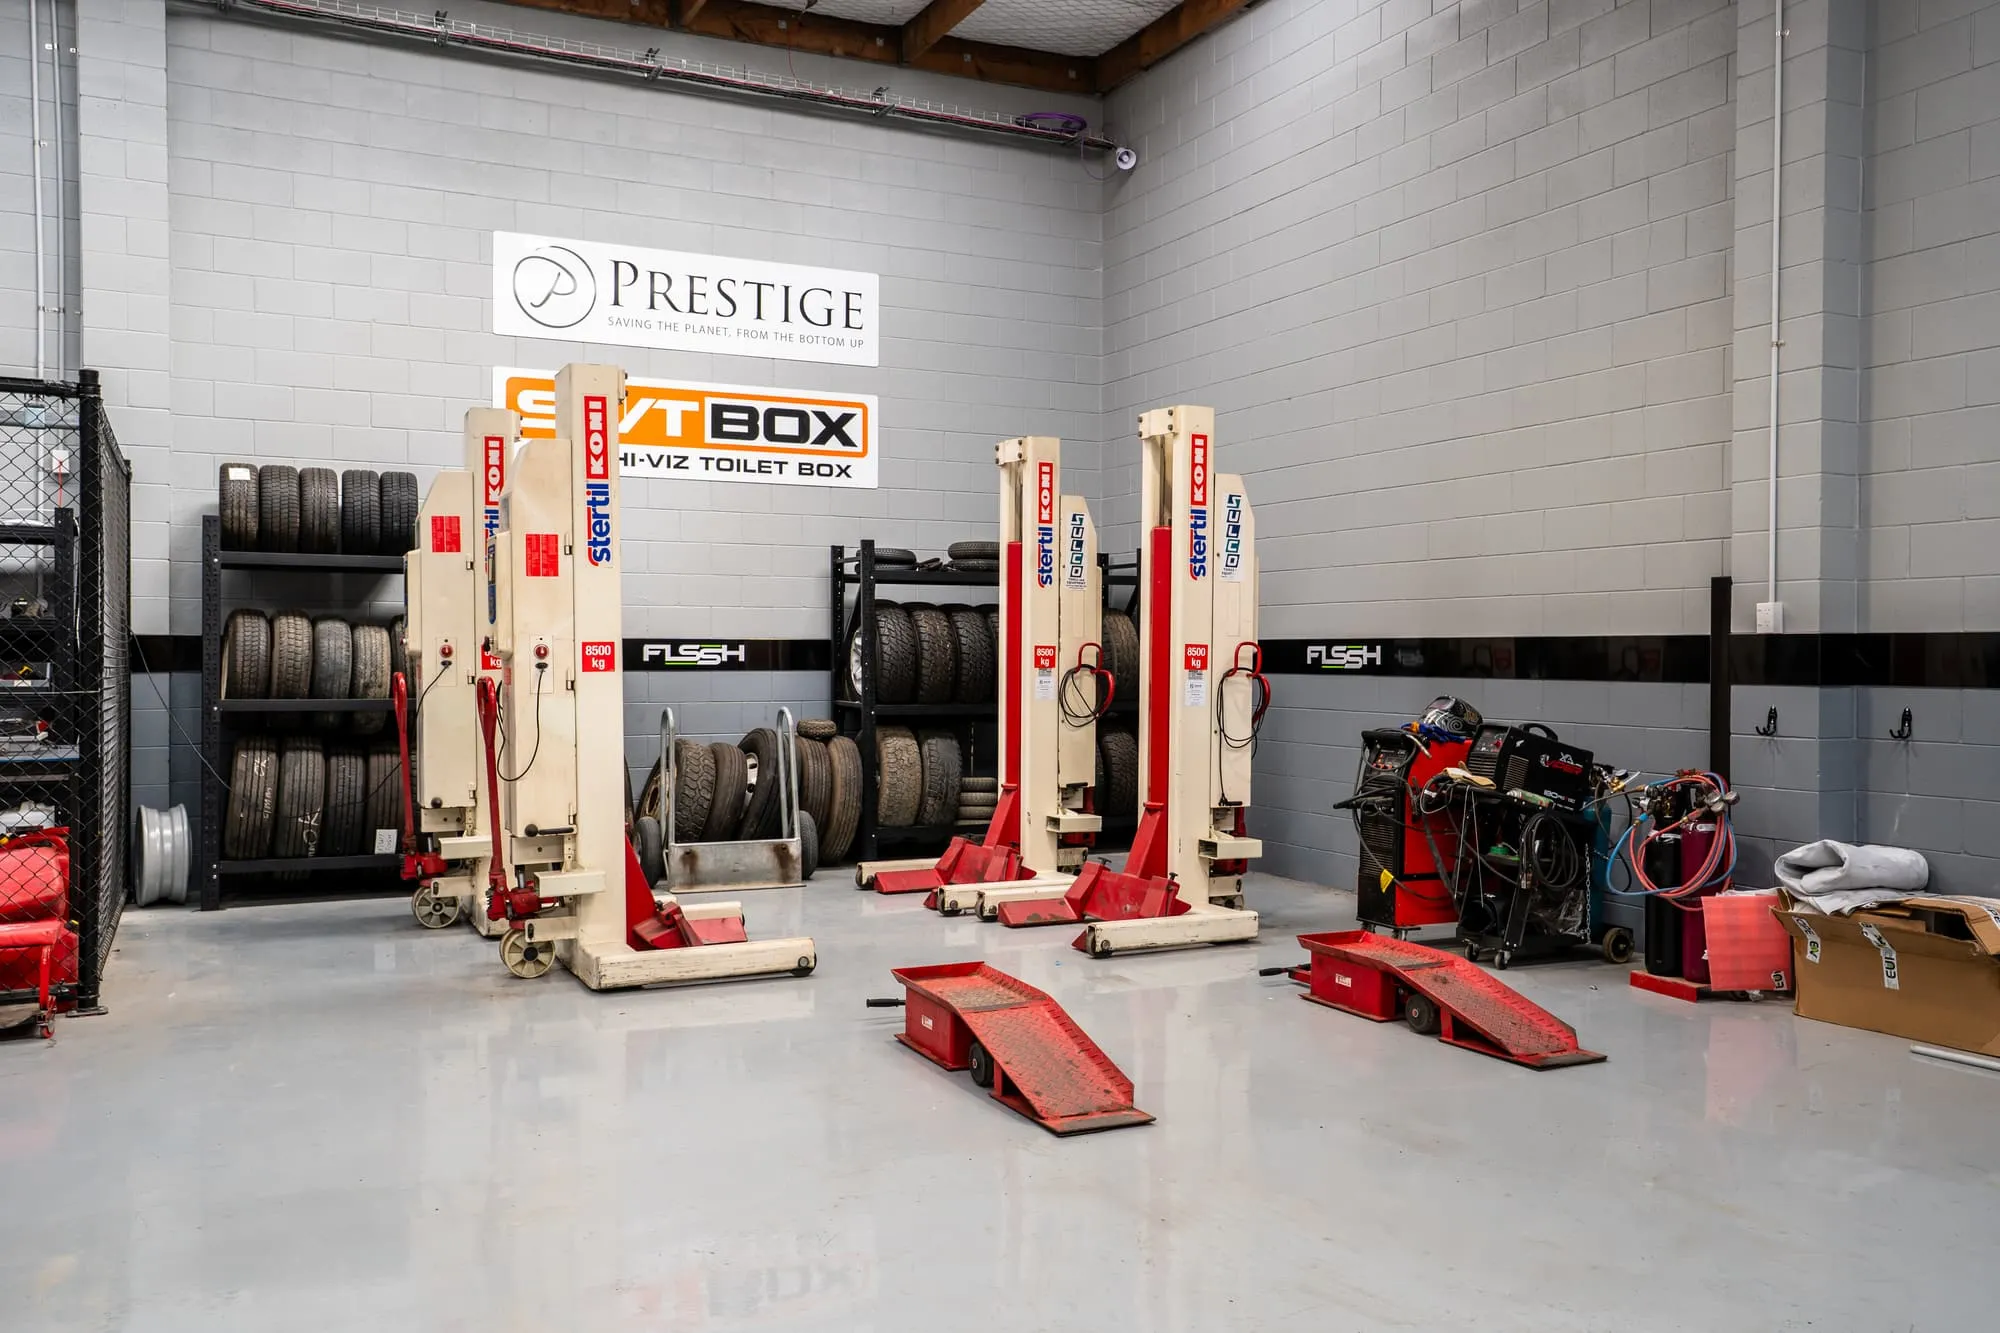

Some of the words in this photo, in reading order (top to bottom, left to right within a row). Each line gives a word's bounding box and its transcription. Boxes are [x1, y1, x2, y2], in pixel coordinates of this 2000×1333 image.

[608, 259, 864, 331] PRESTIGE
[608, 316, 652, 330] SAVING
[658, 321, 680, 333] THE
[685, 323, 732, 339] PLANET,
[736, 327, 769, 341] FROM
[773, 331, 795, 343] THE
[799, 334, 846, 348] BOTTOM
[850, 338, 865, 349] UP
[589, 400, 605, 476] KONI
[710, 403, 858, 448] BOX
[487, 440, 501, 503] KONI
[700, 457, 788, 475] TOILET
[799, 462, 853, 479] BOX
[1193, 438, 1205, 502] KONI
[1041, 466, 1051, 521] KONI
[586, 483, 612, 567] stertil
[1038, 527, 1053, 589] stertil
[1189, 509, 1207, 581] stertil
[490, 657, 502, 669] kg
[585, 645, 611, 657] 8500
[591, 657, 606, 670] kg
[1036, 648, 1054, 657] 8500
[1040, 657, 1050, 667] kg
[1187, 647, 1206, 657] 8500
[1191, 657, 1202, 669] kg
